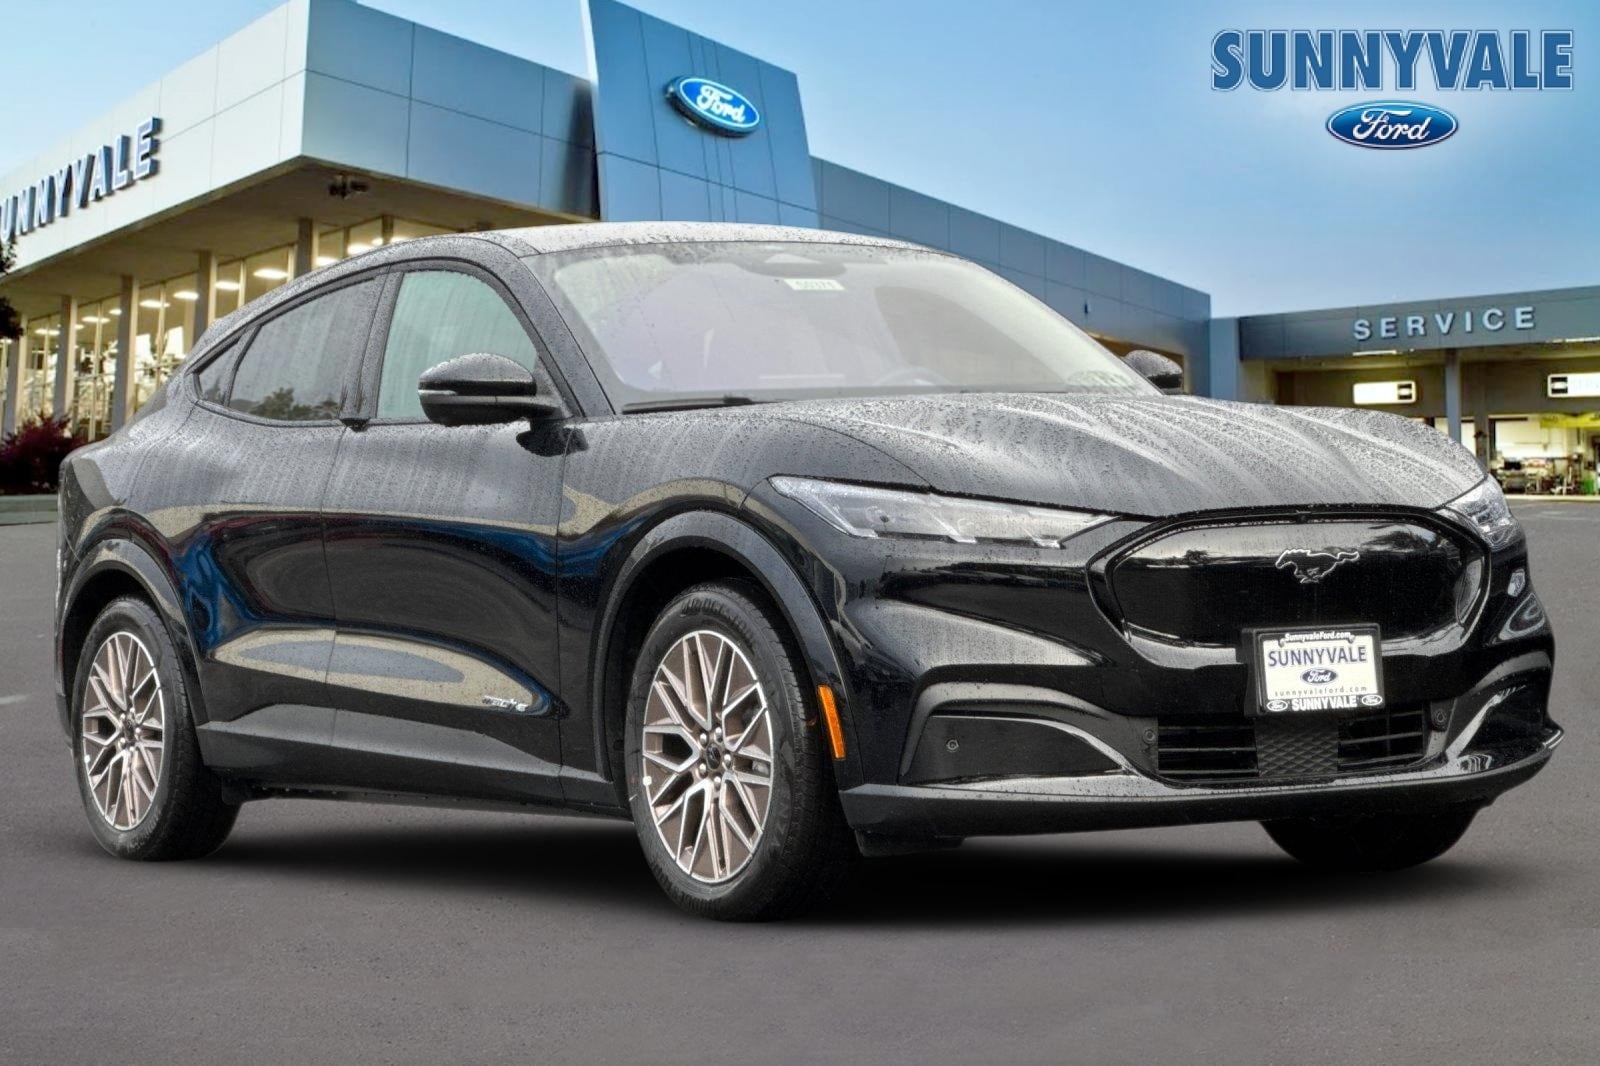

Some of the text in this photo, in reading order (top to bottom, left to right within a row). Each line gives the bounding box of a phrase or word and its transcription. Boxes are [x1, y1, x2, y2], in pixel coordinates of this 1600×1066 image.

[697, 85, 745, 122] Ford
[0, 117, 162, 243] UNNYVALE
[1353, 306, 1535, 340] SERVICE
[1268, 645, 1368, 667] SUNNYVALE
[1307, 670, 1331, 682] Ford
[1274, 685, 1367, 697] sunnyvaleford.com
[1291, 695, 1358, 711] SUNNYVALE
